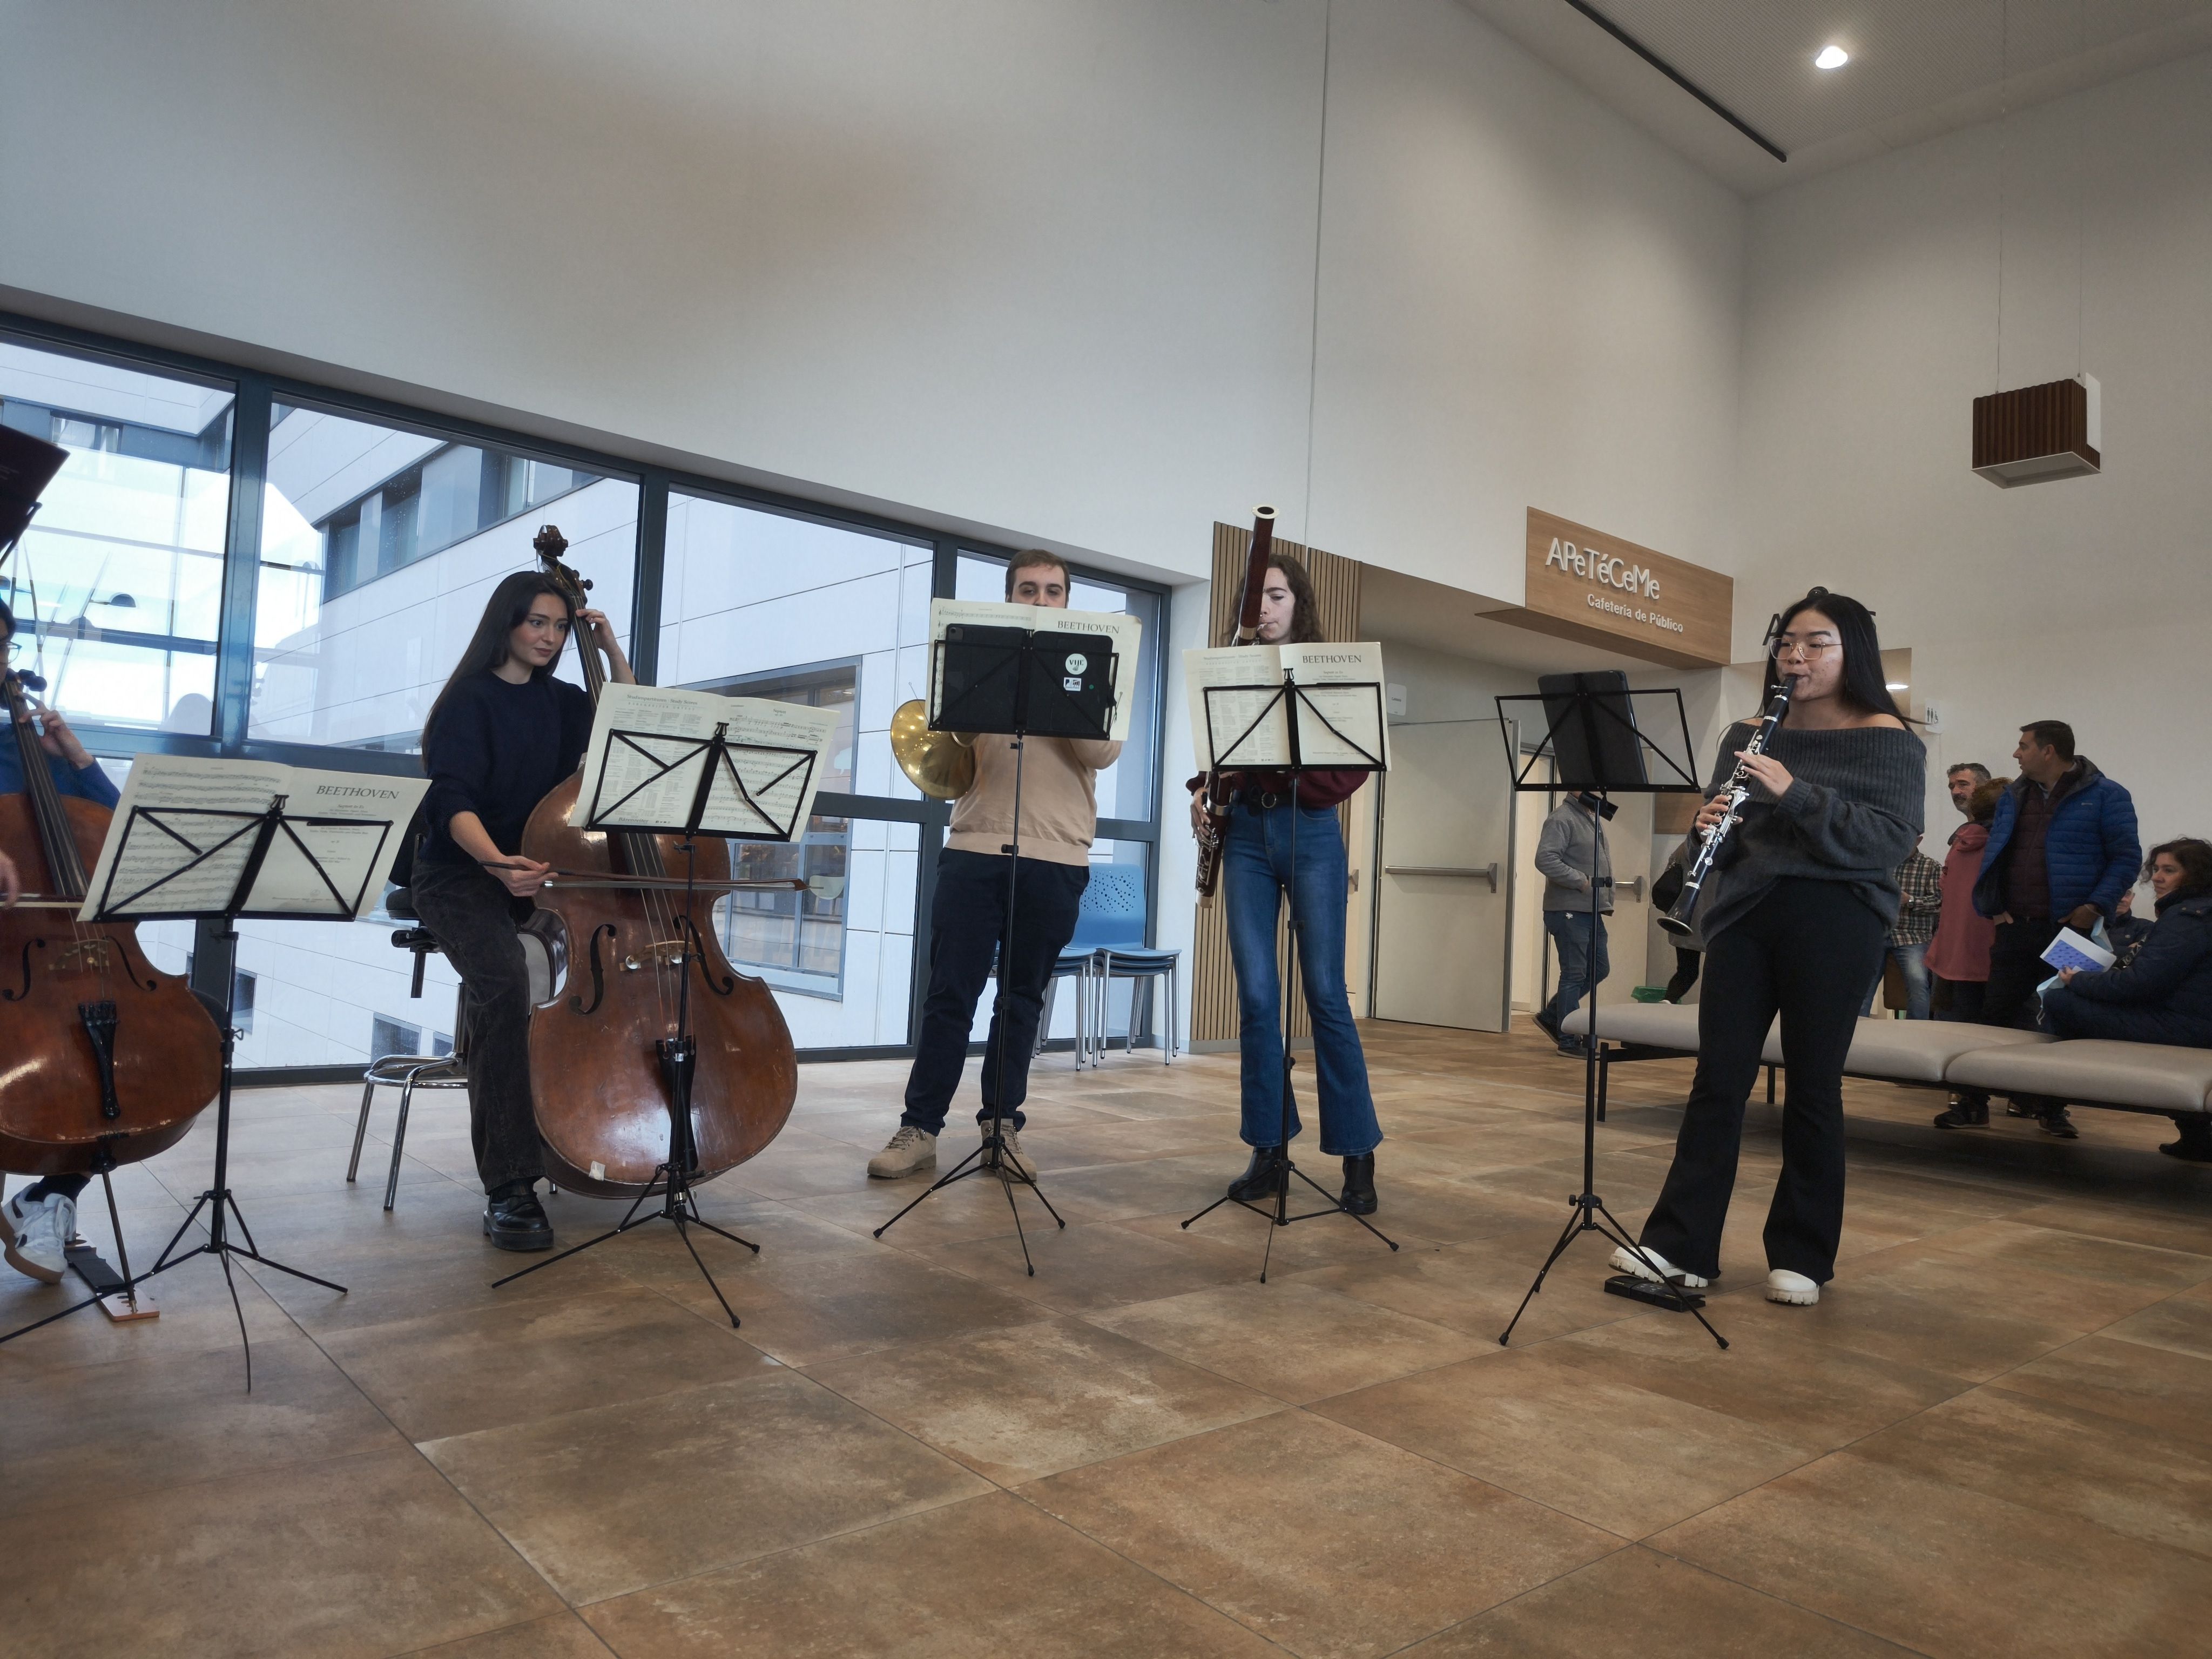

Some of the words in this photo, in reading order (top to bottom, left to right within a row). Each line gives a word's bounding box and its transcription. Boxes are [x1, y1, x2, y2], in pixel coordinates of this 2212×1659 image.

[1588, 594, 1631, 618] Cafetería
[1635, 609, 1647, 622] de
[1649, 612, 1683, 632] Público
[1057, 621, 1120, 634] BEETHOVEN
[1302, 655, 1361, 664] BEETHOVEN
[316, 785, 399, 799] BEETHOVEN
